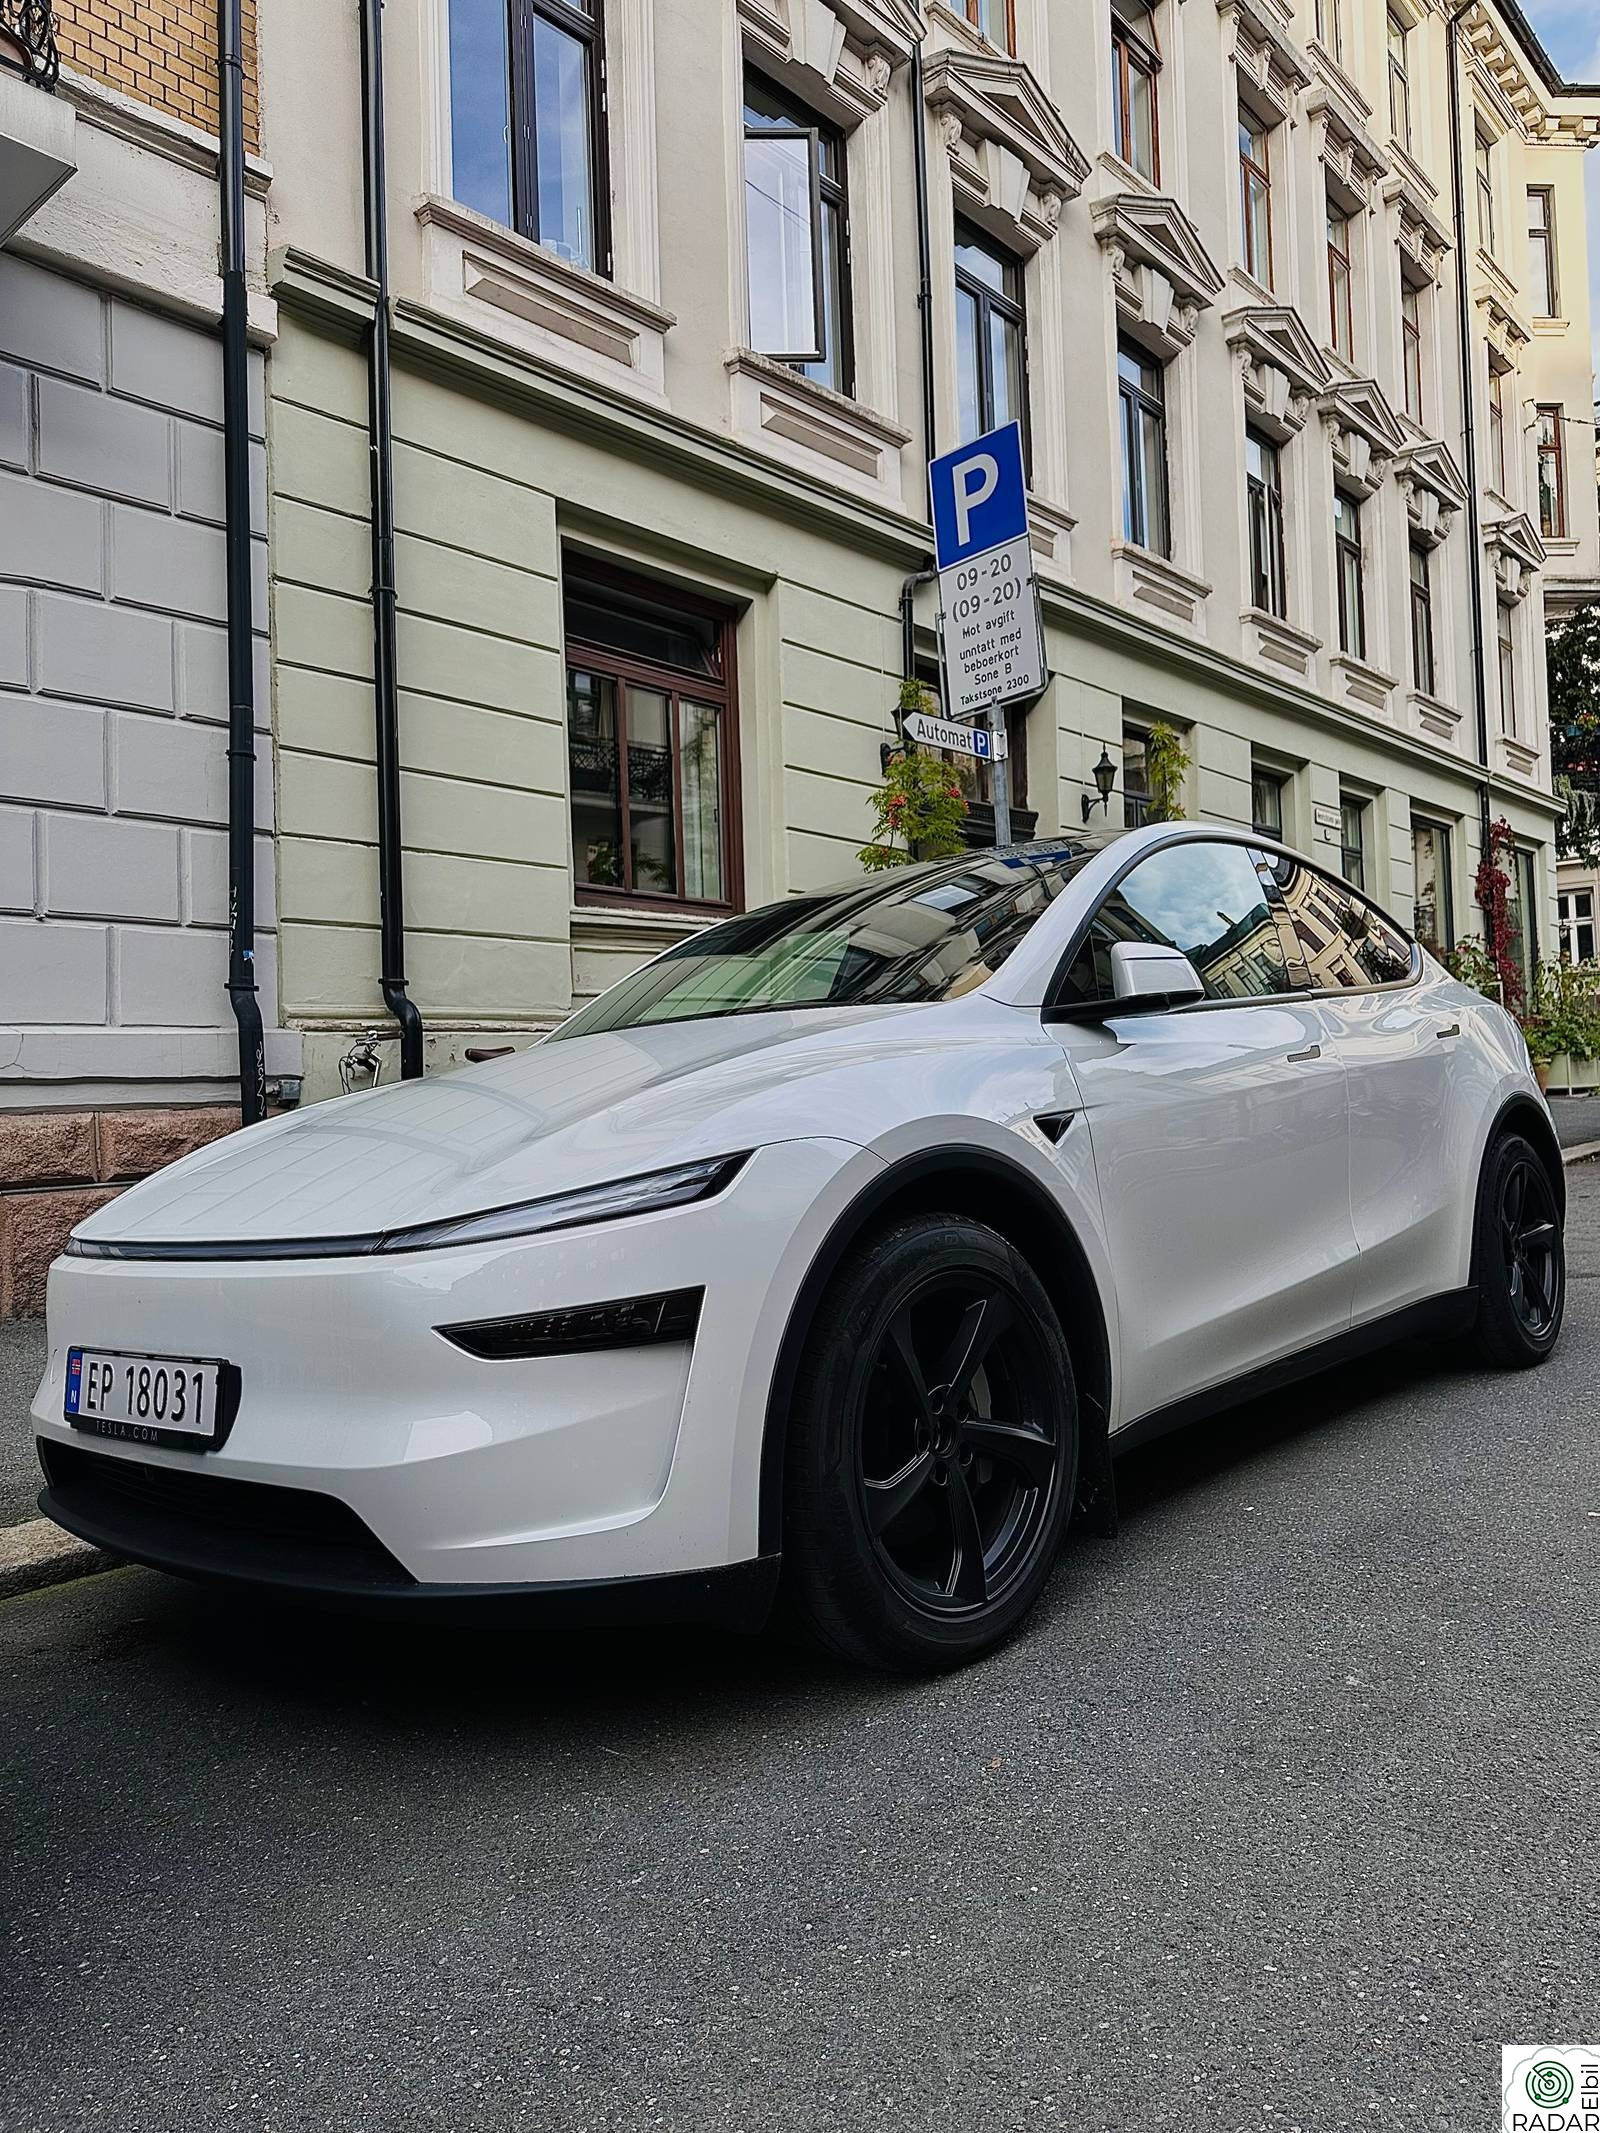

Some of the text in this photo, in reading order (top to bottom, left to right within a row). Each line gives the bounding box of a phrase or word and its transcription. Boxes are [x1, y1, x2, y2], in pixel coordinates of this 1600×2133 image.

[952, 453, 999, 547] P
[962, 610, 1015, 639] Mot avgift
[959, 627, 1022, 660] unntatt med
[964, 645, 1019, 674] beboerkort
[974, 662, 1012, 686] Sone B
[960, 674, 1029, 705] Takstsone 2300
[917, 719, 986, 753] Automat P
[70, 1389, 77, 1404] N
[86, 1361, 203, 1424] EP 18031
[96, 1420, 159, 1441] TESLA.COM
